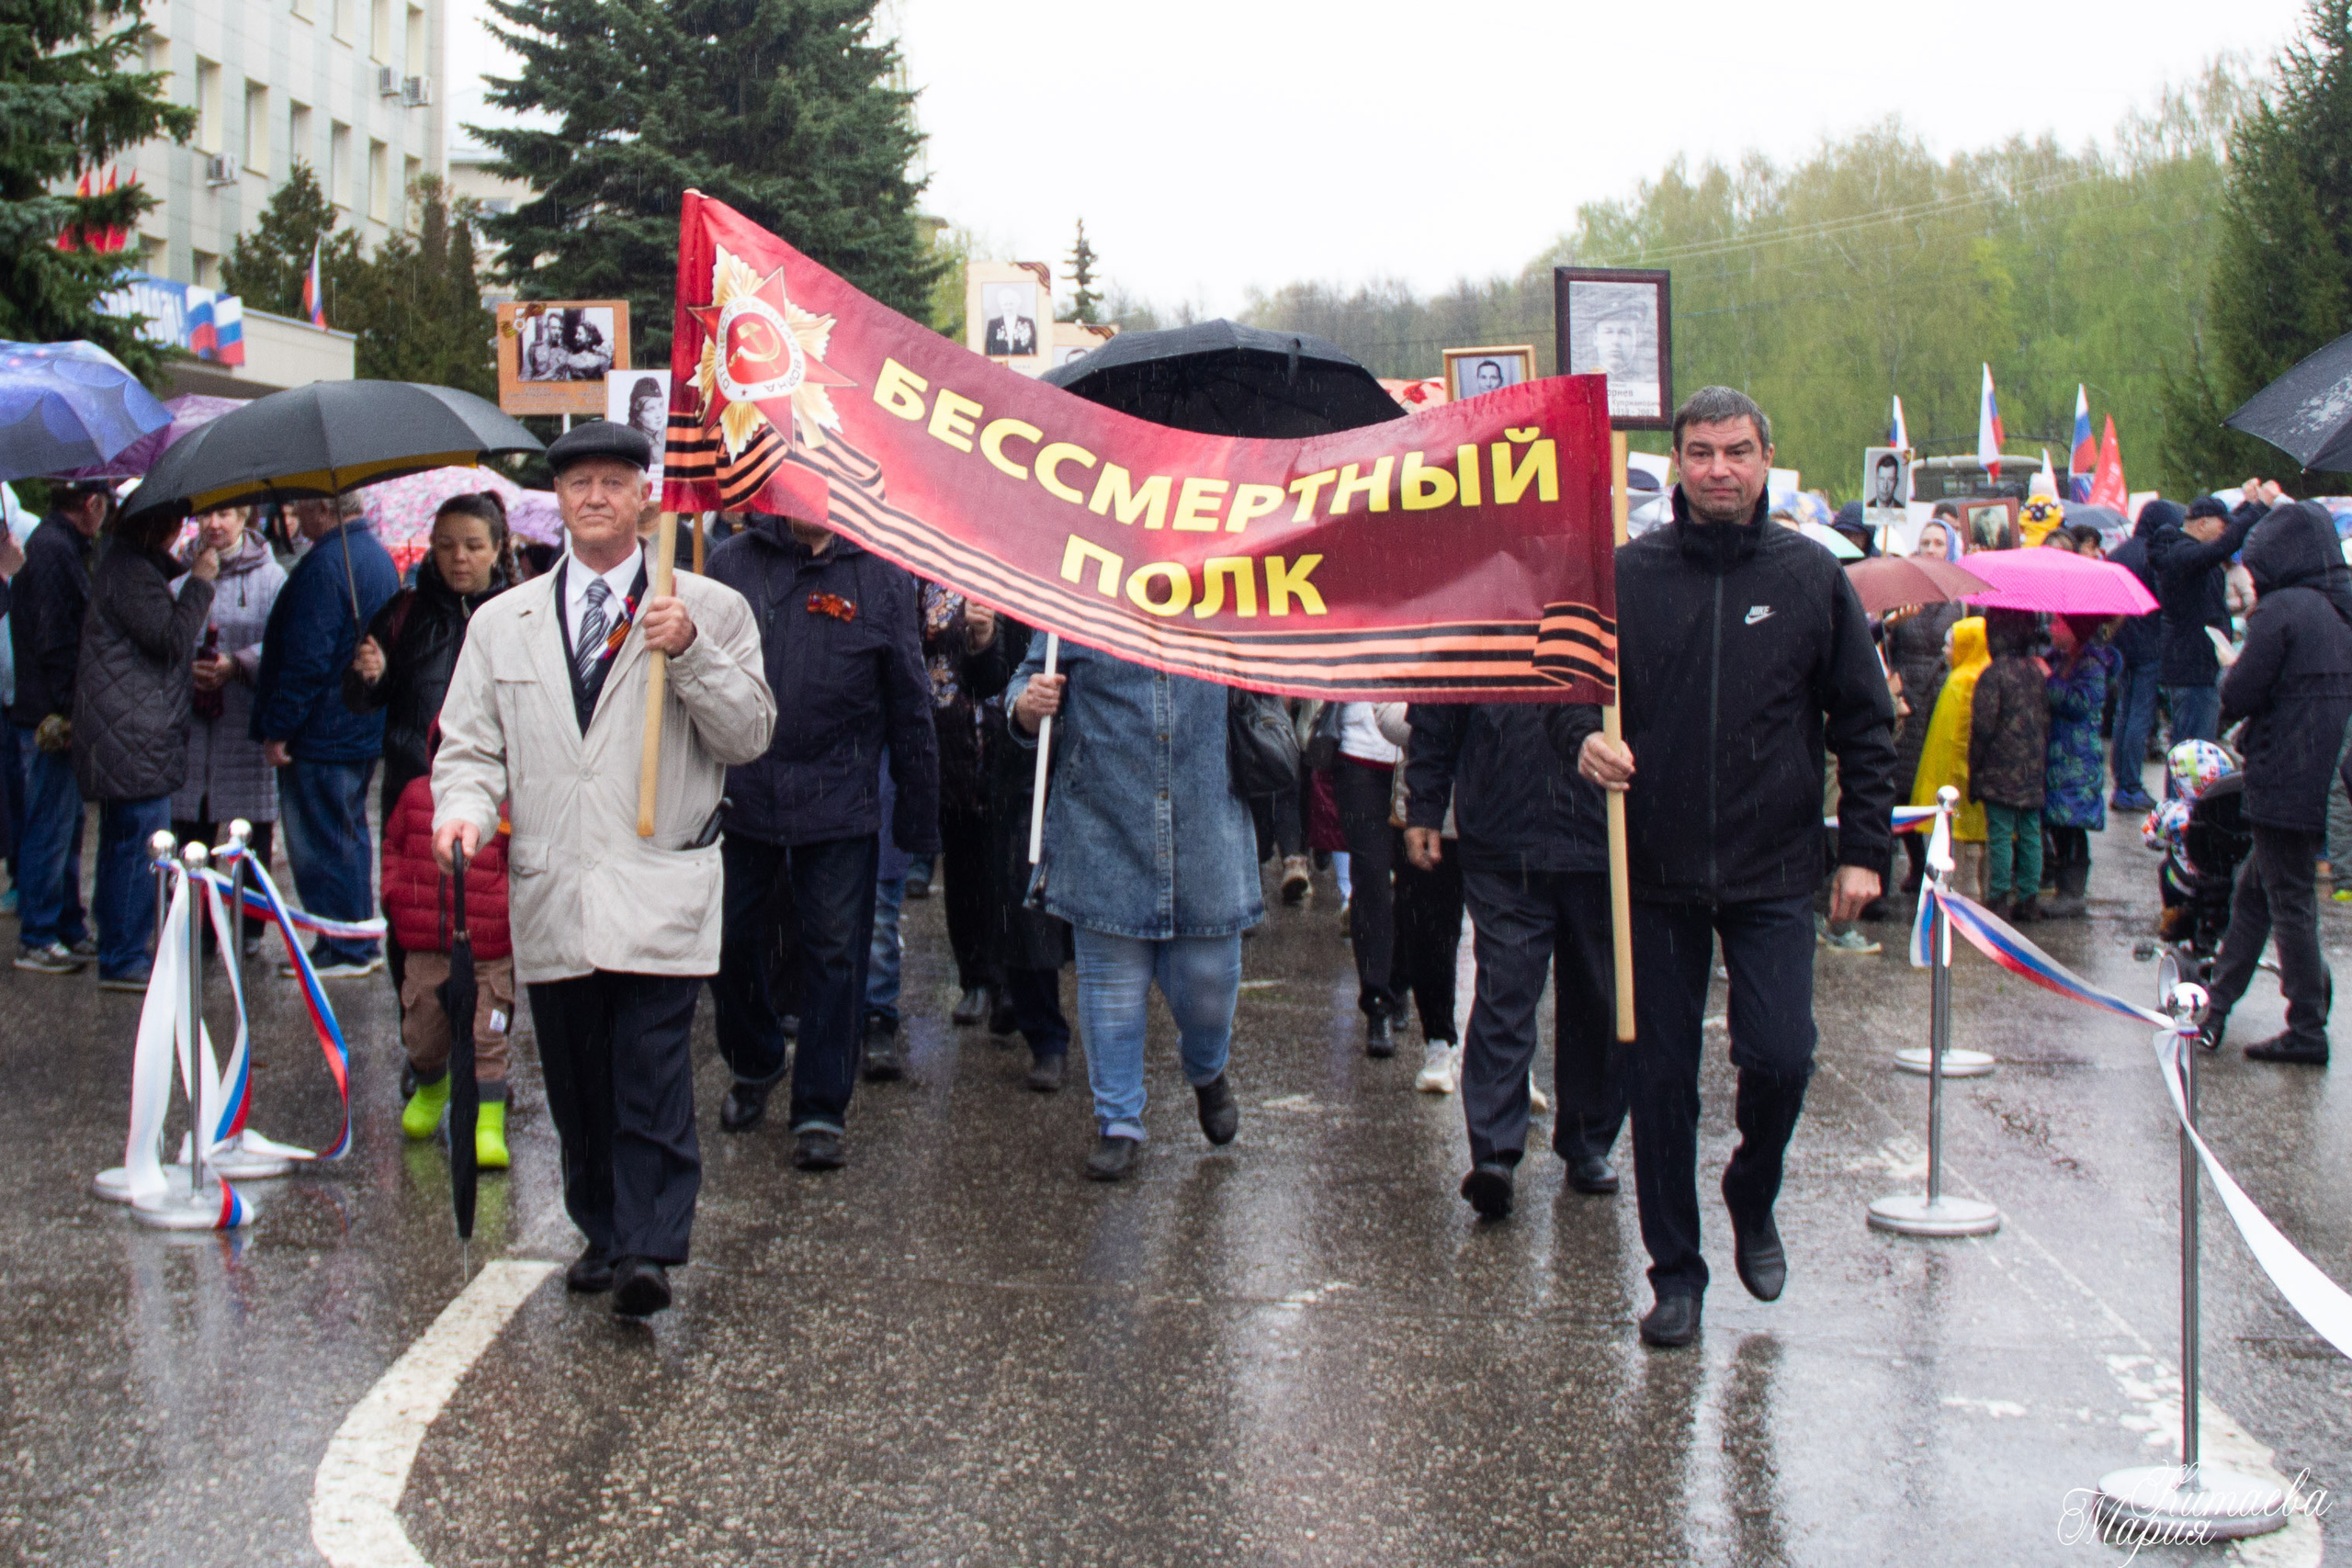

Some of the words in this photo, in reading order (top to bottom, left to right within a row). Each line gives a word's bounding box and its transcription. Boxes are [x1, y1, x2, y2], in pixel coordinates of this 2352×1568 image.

[873, 357, 1559, 533] БЕССМЕРТНЫЙ
[1060, 533, 1328, 620] ПОЛК
[1748, 605, 1770, 616] NIKE
